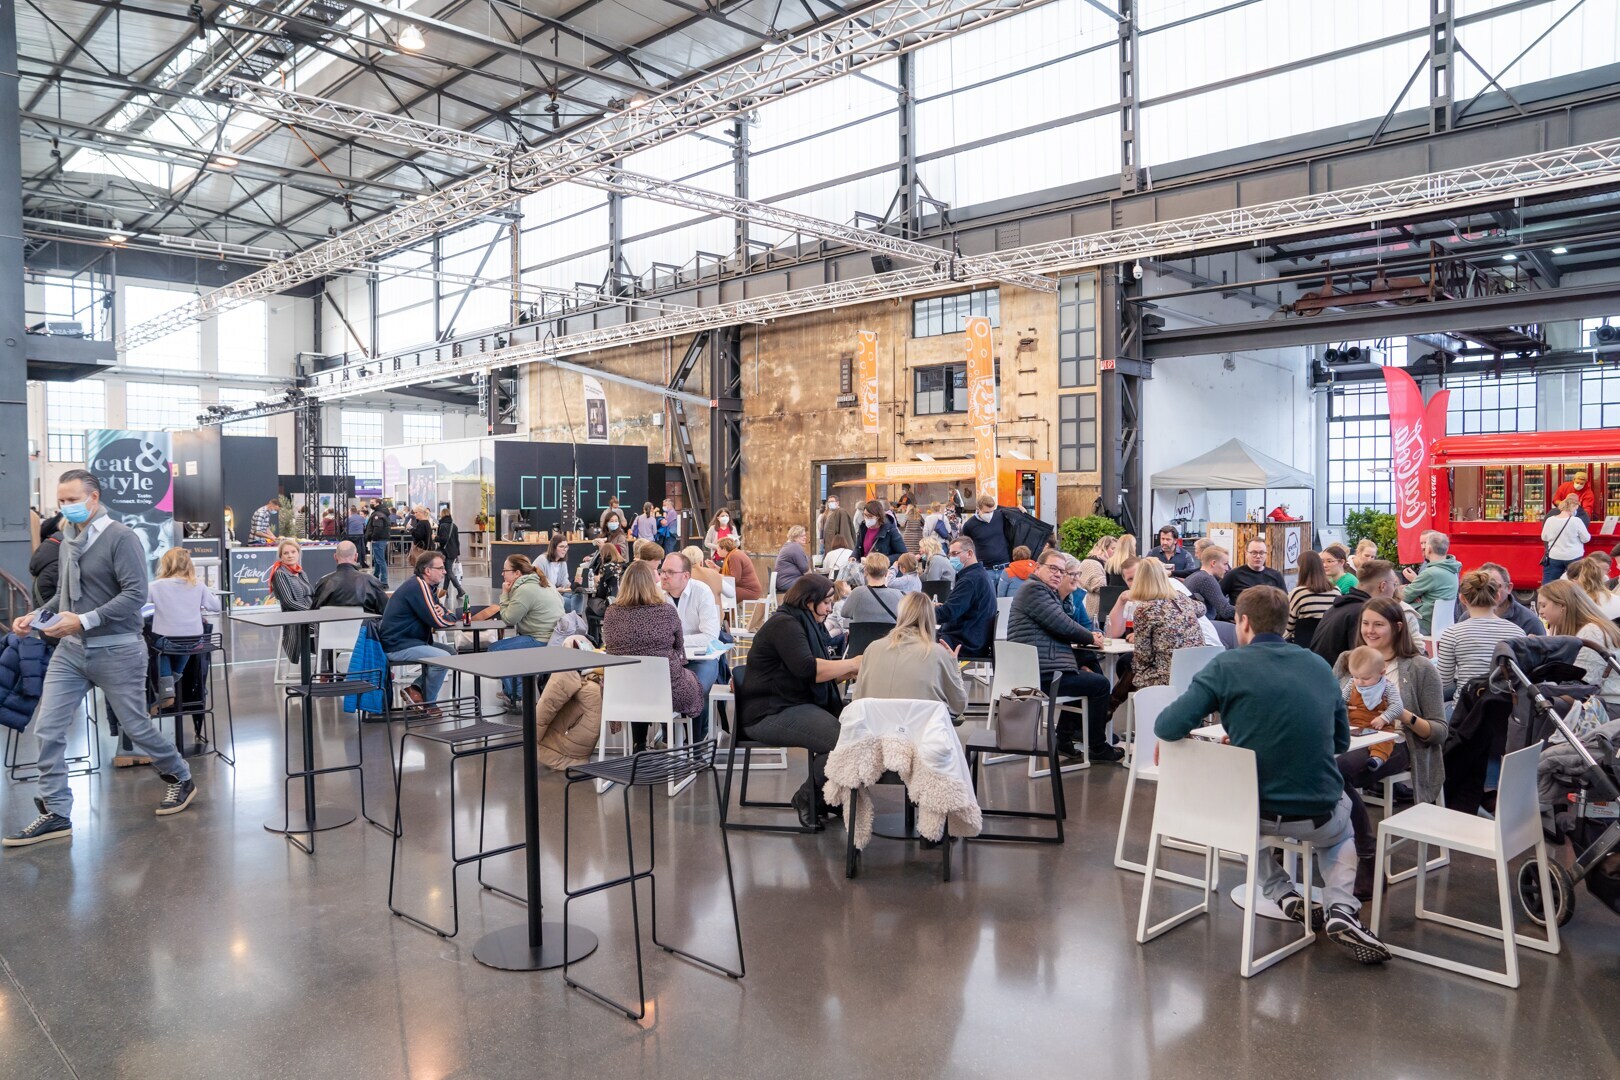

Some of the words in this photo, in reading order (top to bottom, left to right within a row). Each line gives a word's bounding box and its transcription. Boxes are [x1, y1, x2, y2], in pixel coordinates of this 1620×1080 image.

[94, 456, 133, 472] eat
[135, 437, 168, 473] &
[98, 472, 153, 495] style
[521, 476, 631, 510] COFFEE
[1176, 503, 1192, 517] vnt
